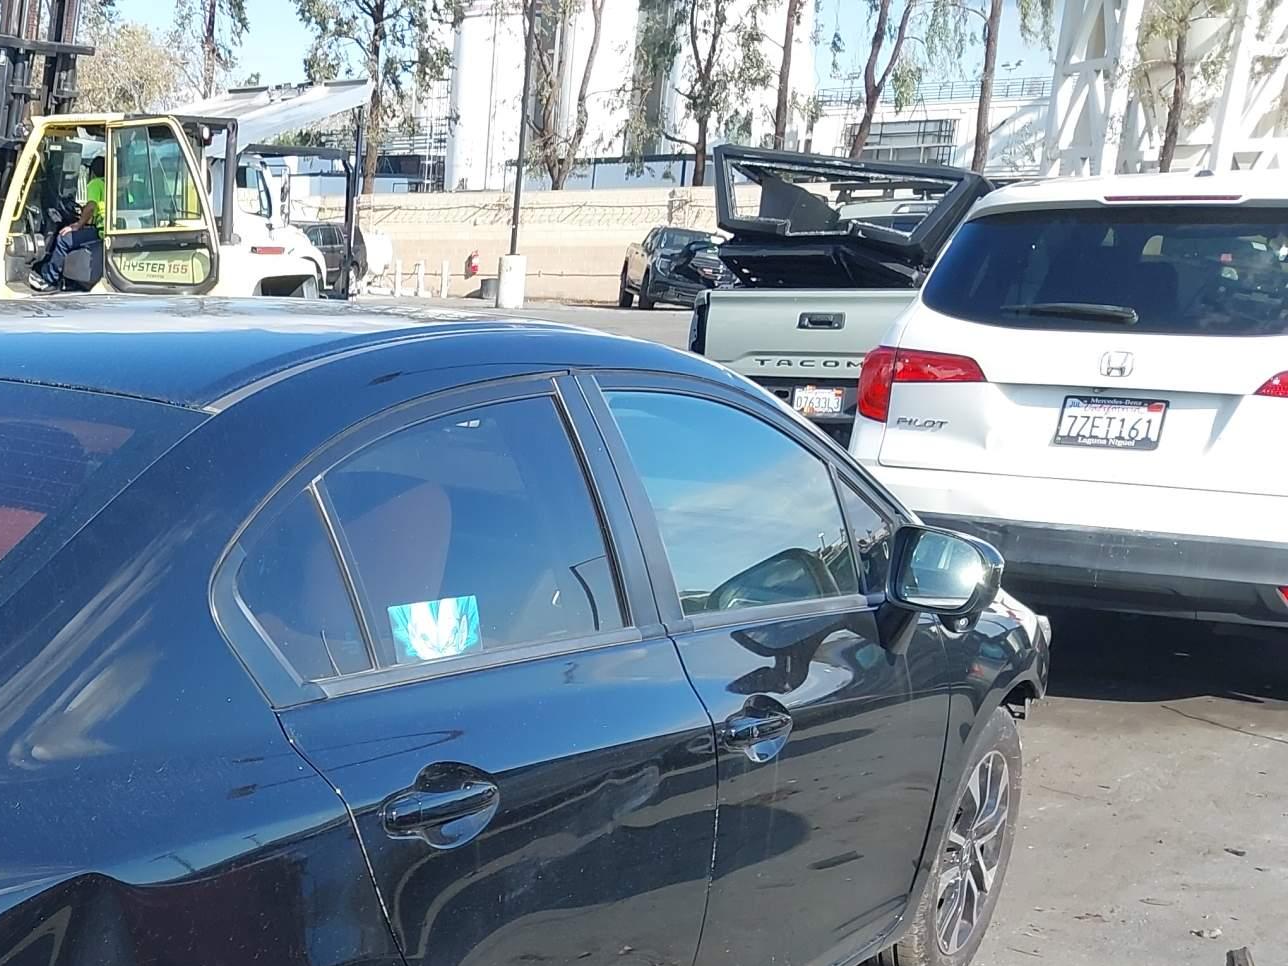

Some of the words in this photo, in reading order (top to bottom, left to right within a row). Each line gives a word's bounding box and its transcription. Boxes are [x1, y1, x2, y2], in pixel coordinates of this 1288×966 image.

[123, 262, 165, 273] HYSTER
[167, 262, 188, 274] 155
[754, 358, 864, 369] TACOM
[896, 417, 949, 429] PILOT
[1066, 415, 1152, 439] 7ZET161
[1077, 436, 1107, 446] Laguna
[1108, 437, 1136, 448] Niguel
